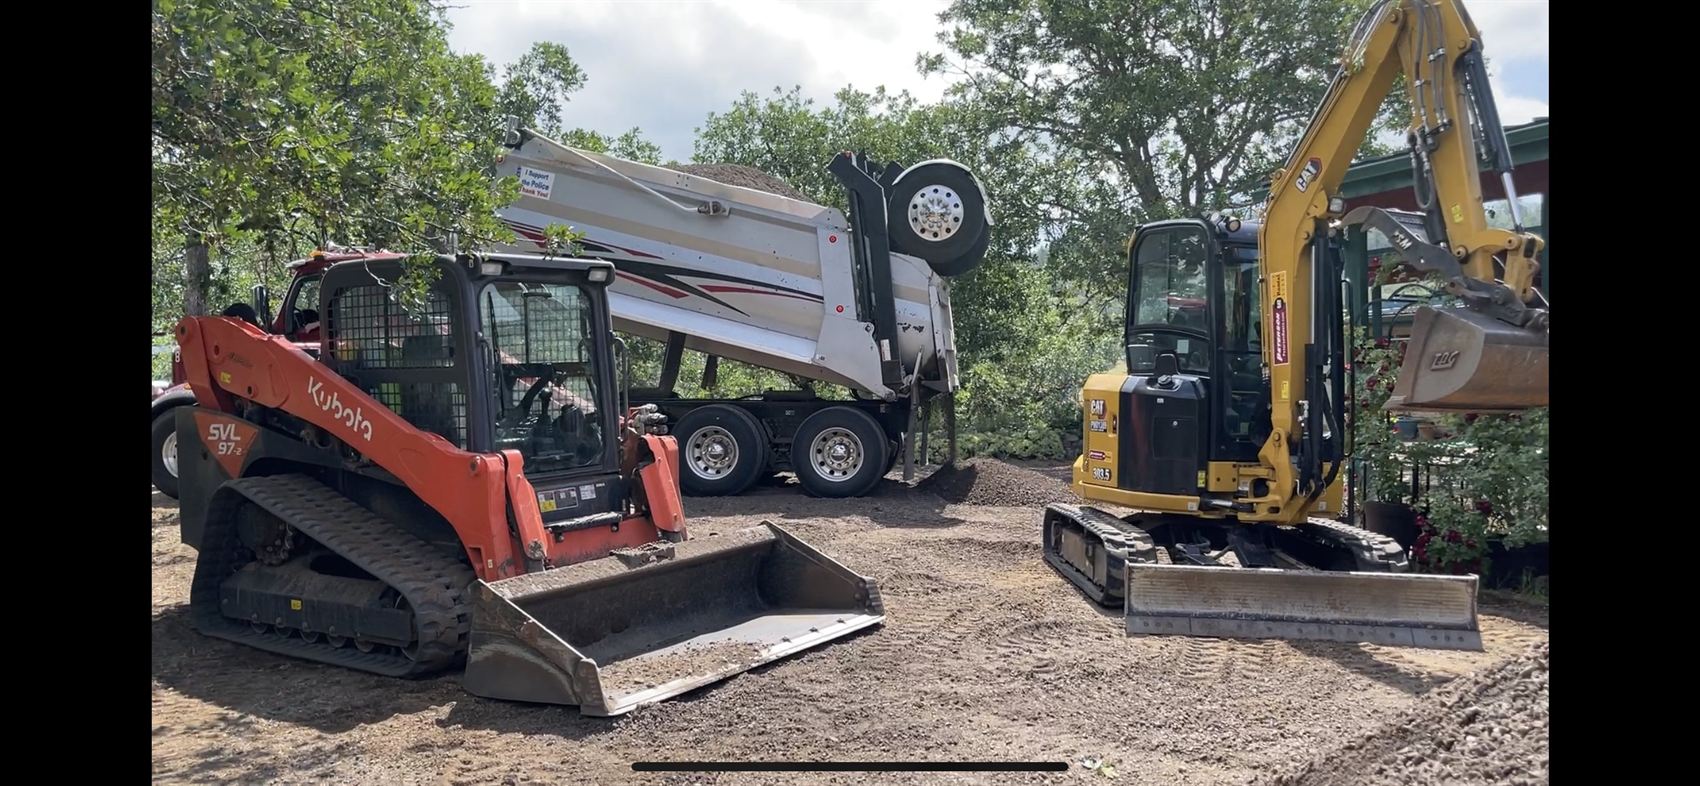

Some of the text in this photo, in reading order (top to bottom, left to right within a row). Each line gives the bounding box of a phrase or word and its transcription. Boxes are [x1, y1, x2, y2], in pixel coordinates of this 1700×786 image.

[529, 170, 549, 180] Support
[1296, 161, 1317, 192] CAT
[520, 187, 535, 195] hank
[530, 180, 549, 190] Police
[307, 375, 373, 442] Kubota
[1091, 400, 1104, 415] CAT
[207, 423, 241, 441] SVL
[218, 442, 242, 455] 97-2
[1093, 467, 1110, 480] 303.5
